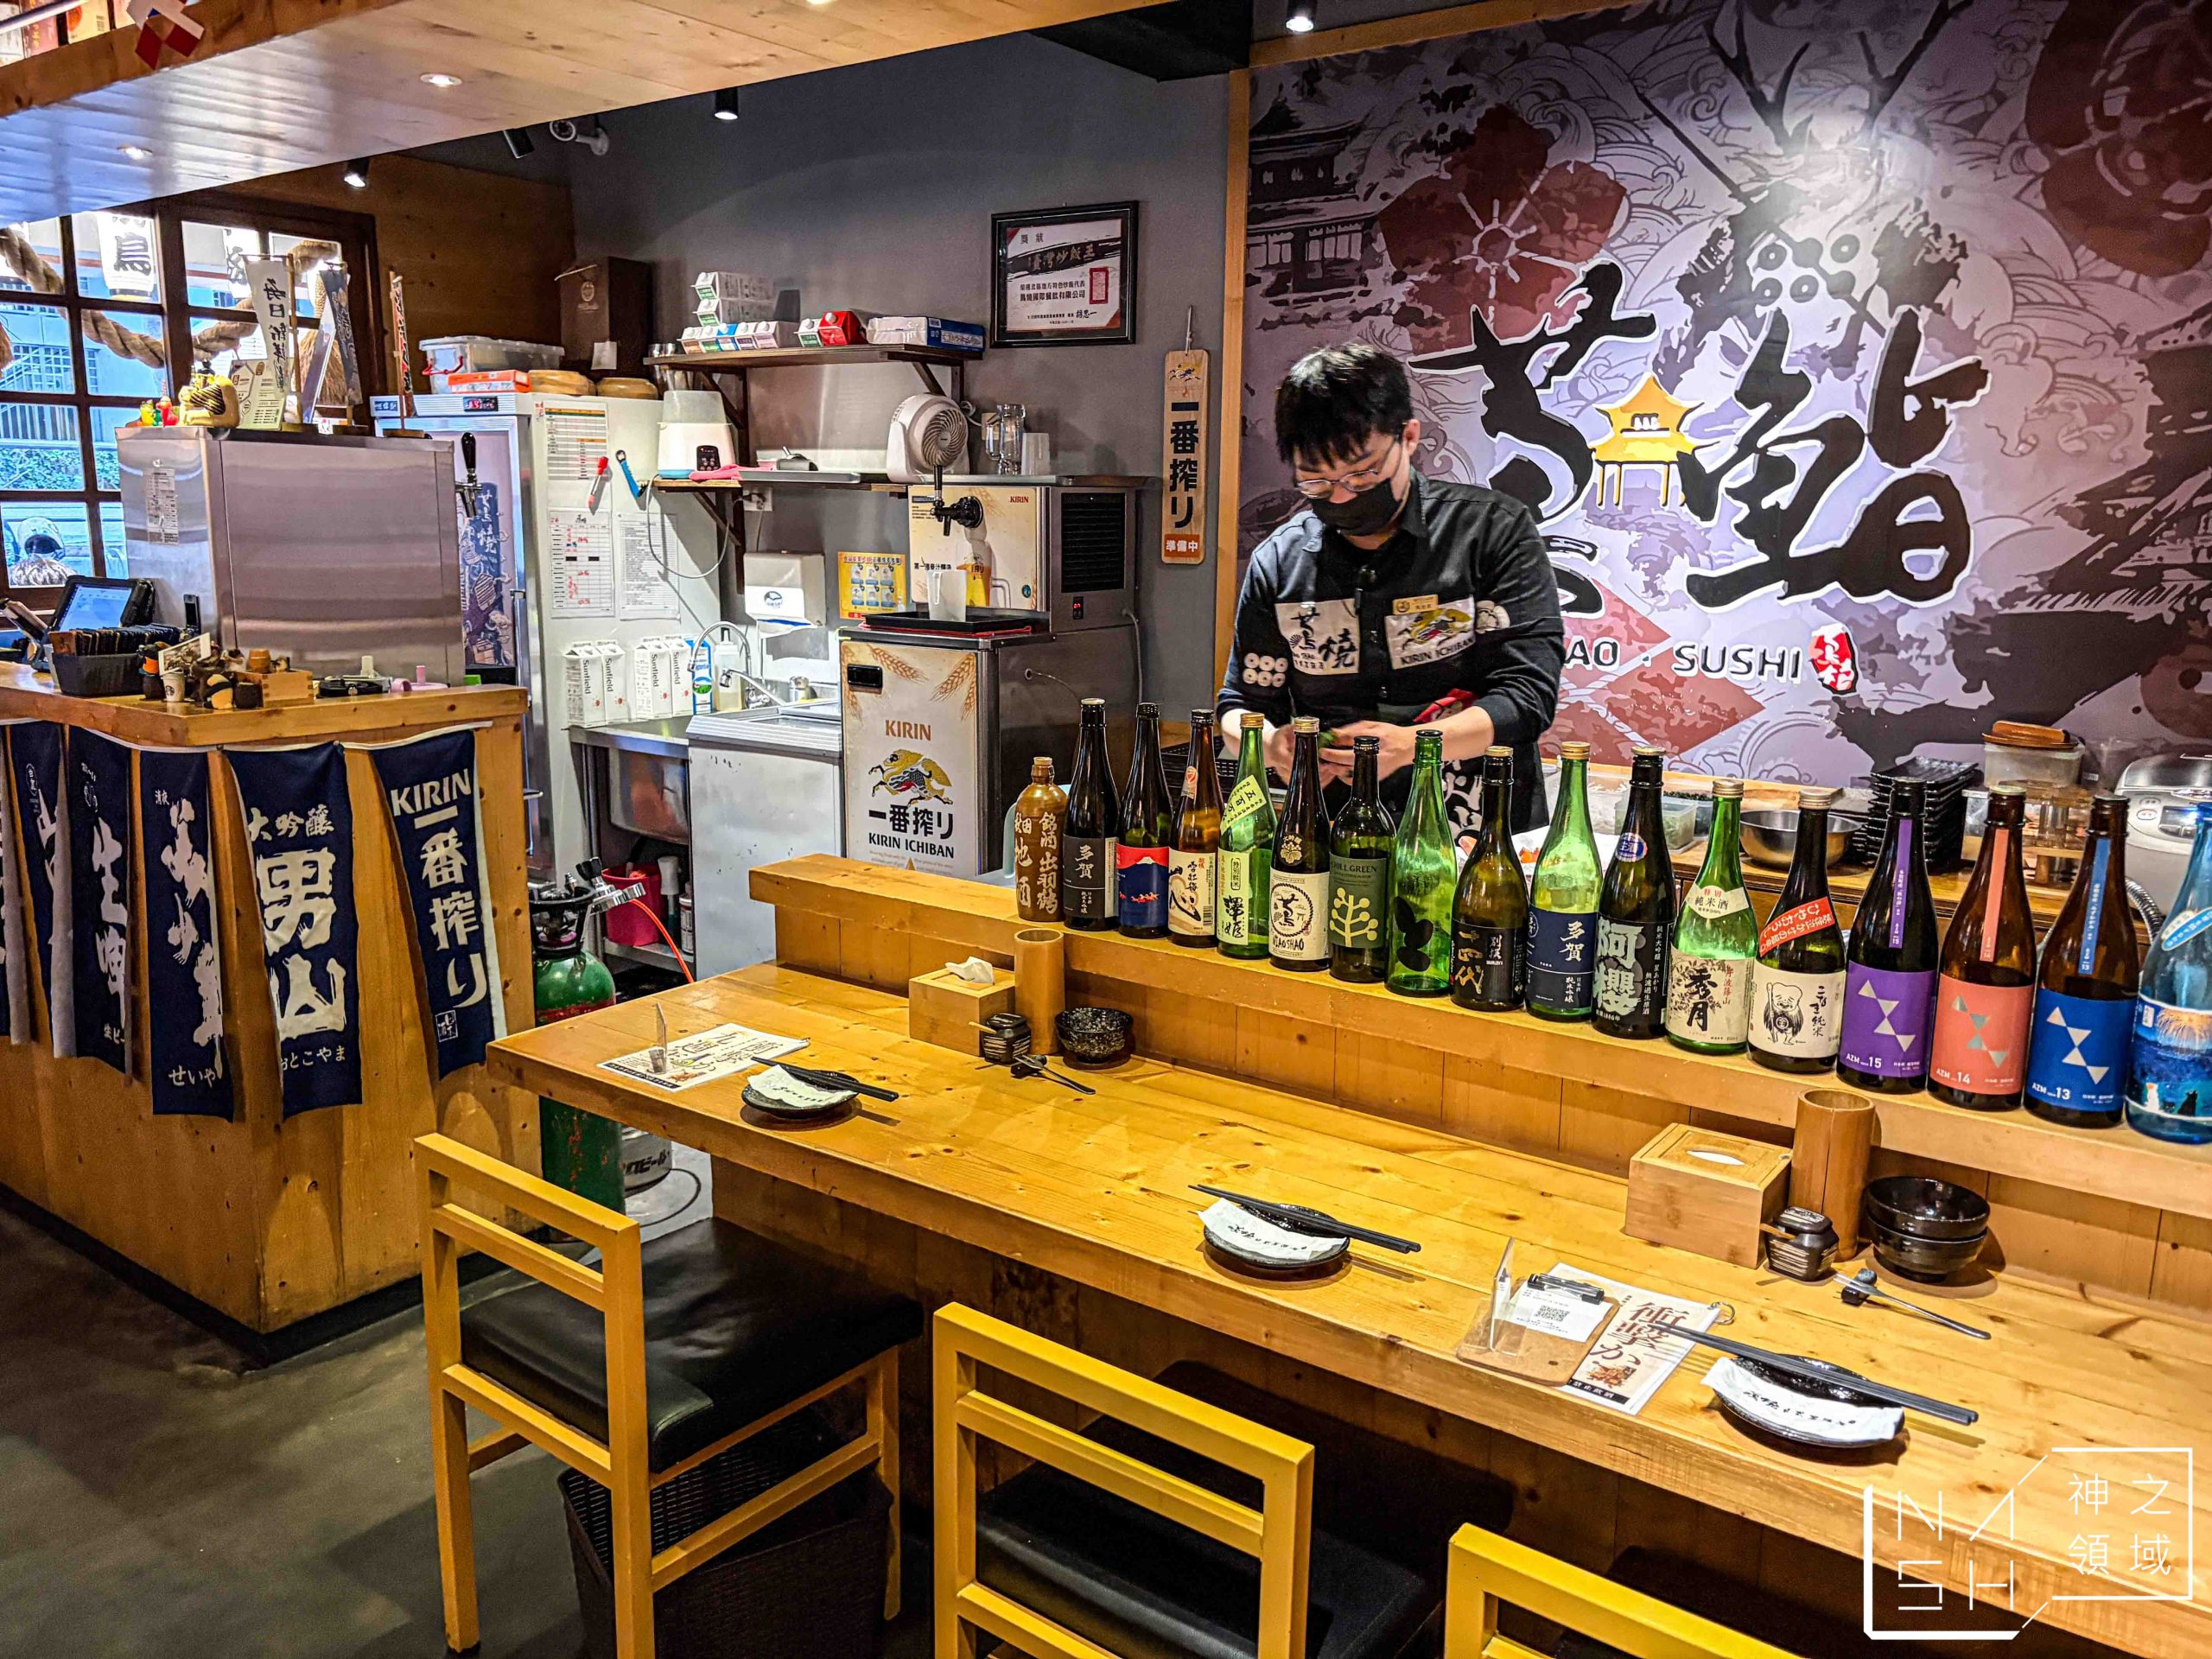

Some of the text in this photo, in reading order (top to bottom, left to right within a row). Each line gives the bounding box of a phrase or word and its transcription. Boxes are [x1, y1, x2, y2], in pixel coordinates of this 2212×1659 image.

[1169, 401, 1199, 529] 一番搾り
[1166, 539, 1199, 554] 準備中
[672, 652, 681, 684] Sunfield
[1401, 637, 1475, 666] KIRIN ICHIBAN
[1562, 639, 1618, 666] AO
[1674, 645, 1801, 679] SUSHI
[582, 659, 592, 695] Sunfield
[605, 658, 614, 692] Sunfield
[651, 653, 659, 687] Sunfield
[885, 720, 932, 741] KIRIN
[391, 768, 472, 817] KIRIN
[868, 804, 954, 840] 一番搾り
[868, 832, 955, 859] KIRIN ICHIBAN
[1074, 844, 1094, 880] 多賀
[1350, 864, 1377, 873] GREEN
[414, 805, 488, 1007] 一番搾り
[1694, 895, 1729, 910] 純米酒
[257, 847, 347, 1041] 男山
[1560, 920, 1586, 963] 多賀
[1685, 968, 1718, 1032] 秀月
[280, 1046, 346, 1071] おとこやま
[1846, 1053, 1860, 1064] AZM
[1868, 1056, 1882, 1069] 15
[168, 1068, 216, 1088] せいや
[1936, 1067, 1950, 1079] AZM
[1957, 1071, 1971, 1084] 14
[2031, 1082, 2048, 1093] AZM
[2056, 1086, 2072, 1100] 13
